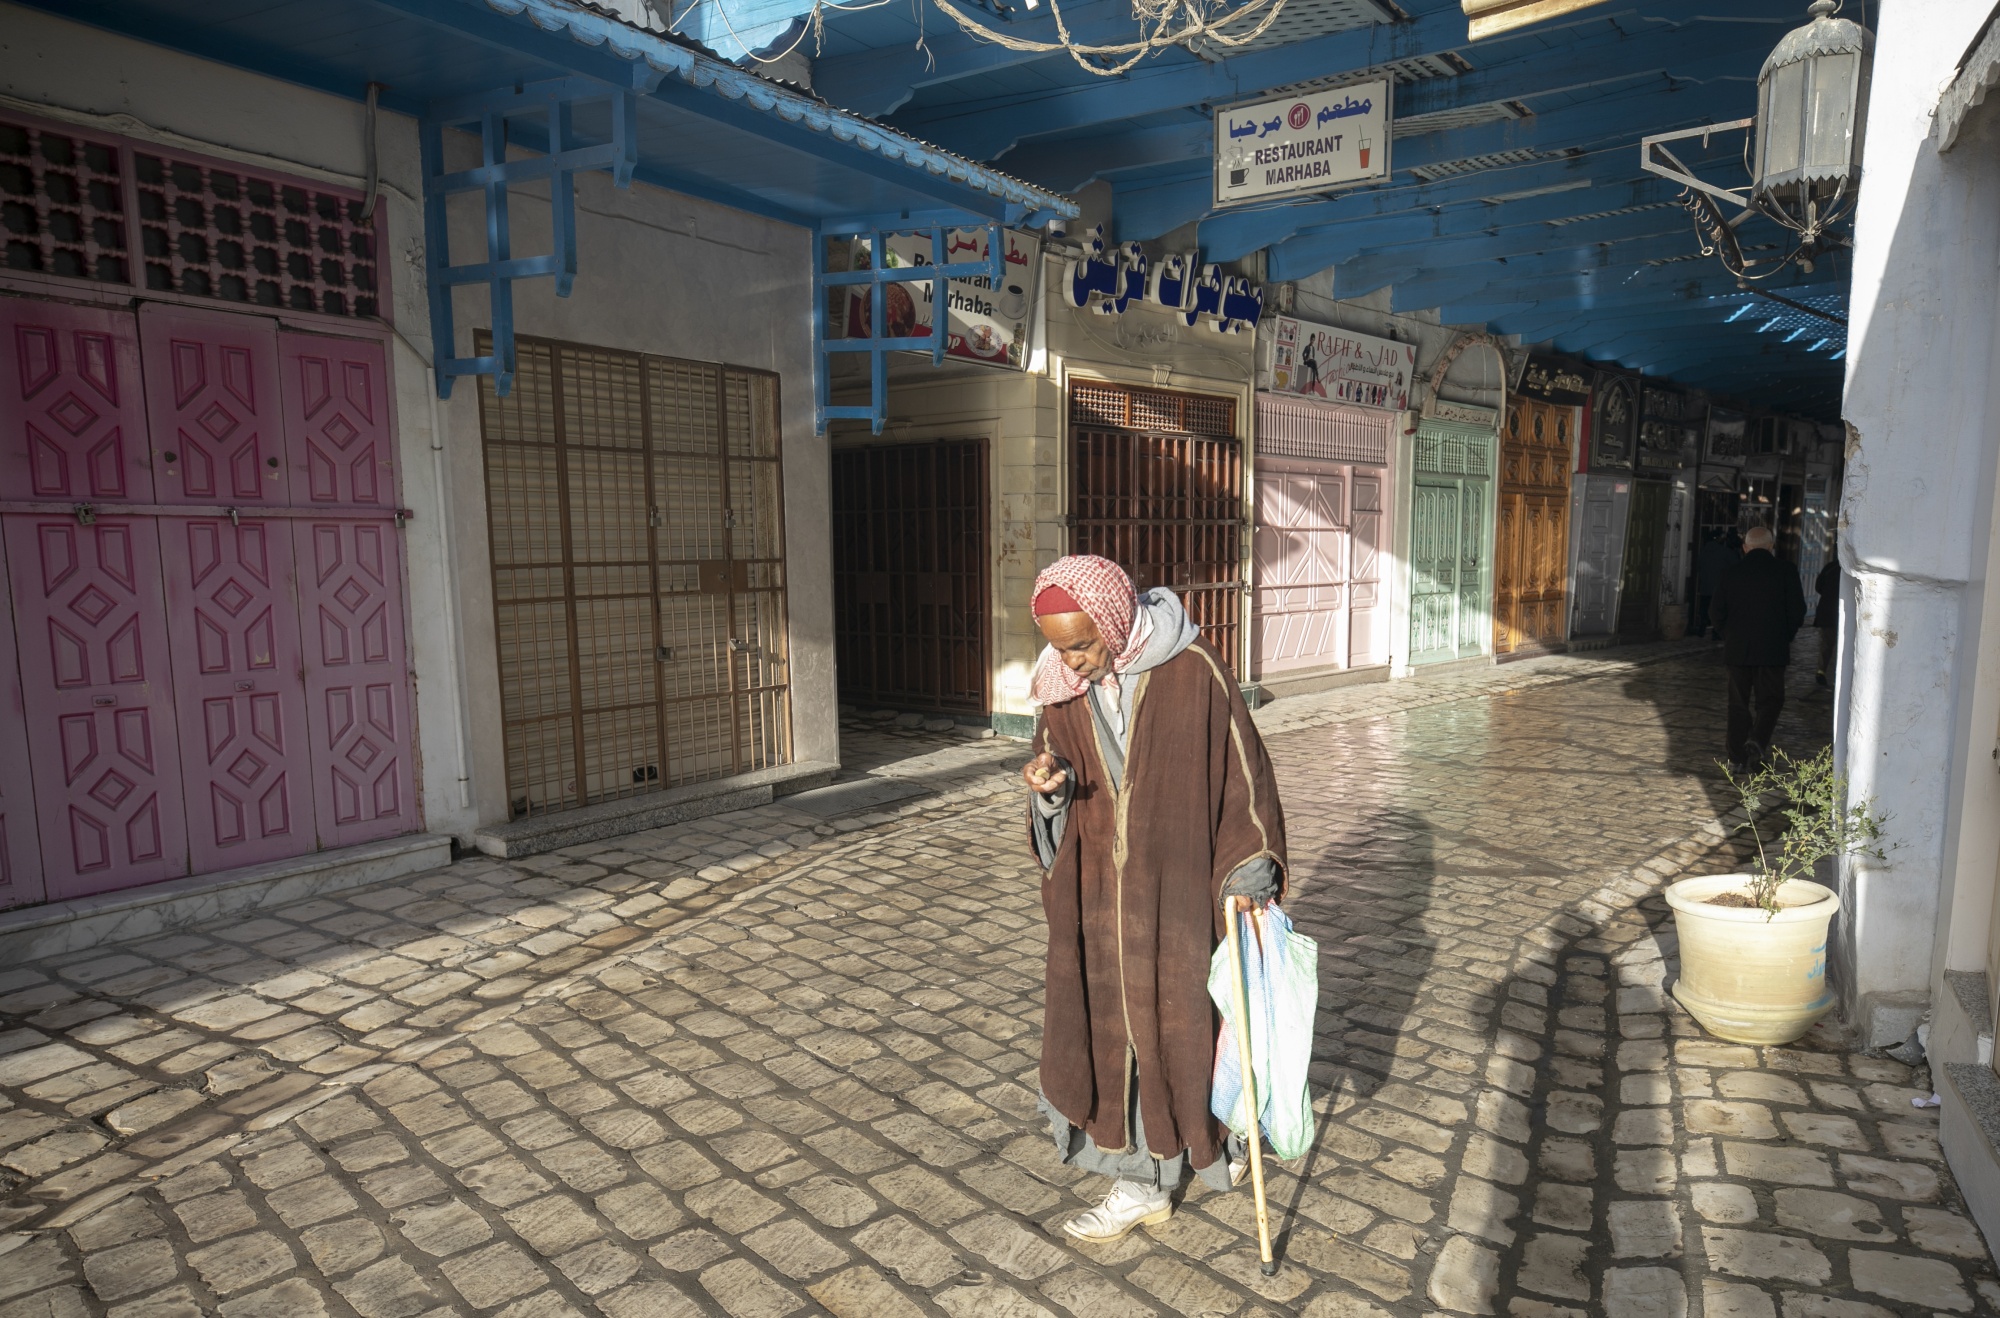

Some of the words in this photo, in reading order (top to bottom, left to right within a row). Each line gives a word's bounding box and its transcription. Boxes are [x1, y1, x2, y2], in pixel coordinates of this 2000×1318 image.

[1229, 114, 1283, 143] مرحبا
[1316, 95, 1373, 131] مطعم
[1255, 134, 1343, 166] RESTAURANT
[1265, 159, 1331, 186] MARHABA
[923, 282, 992, 317] Mrhaba
[1157, 248, 1264, 335] مجوهرات
[1354, 342, 1363, 359] &
[1366, 345, 1398, 367] JAD
